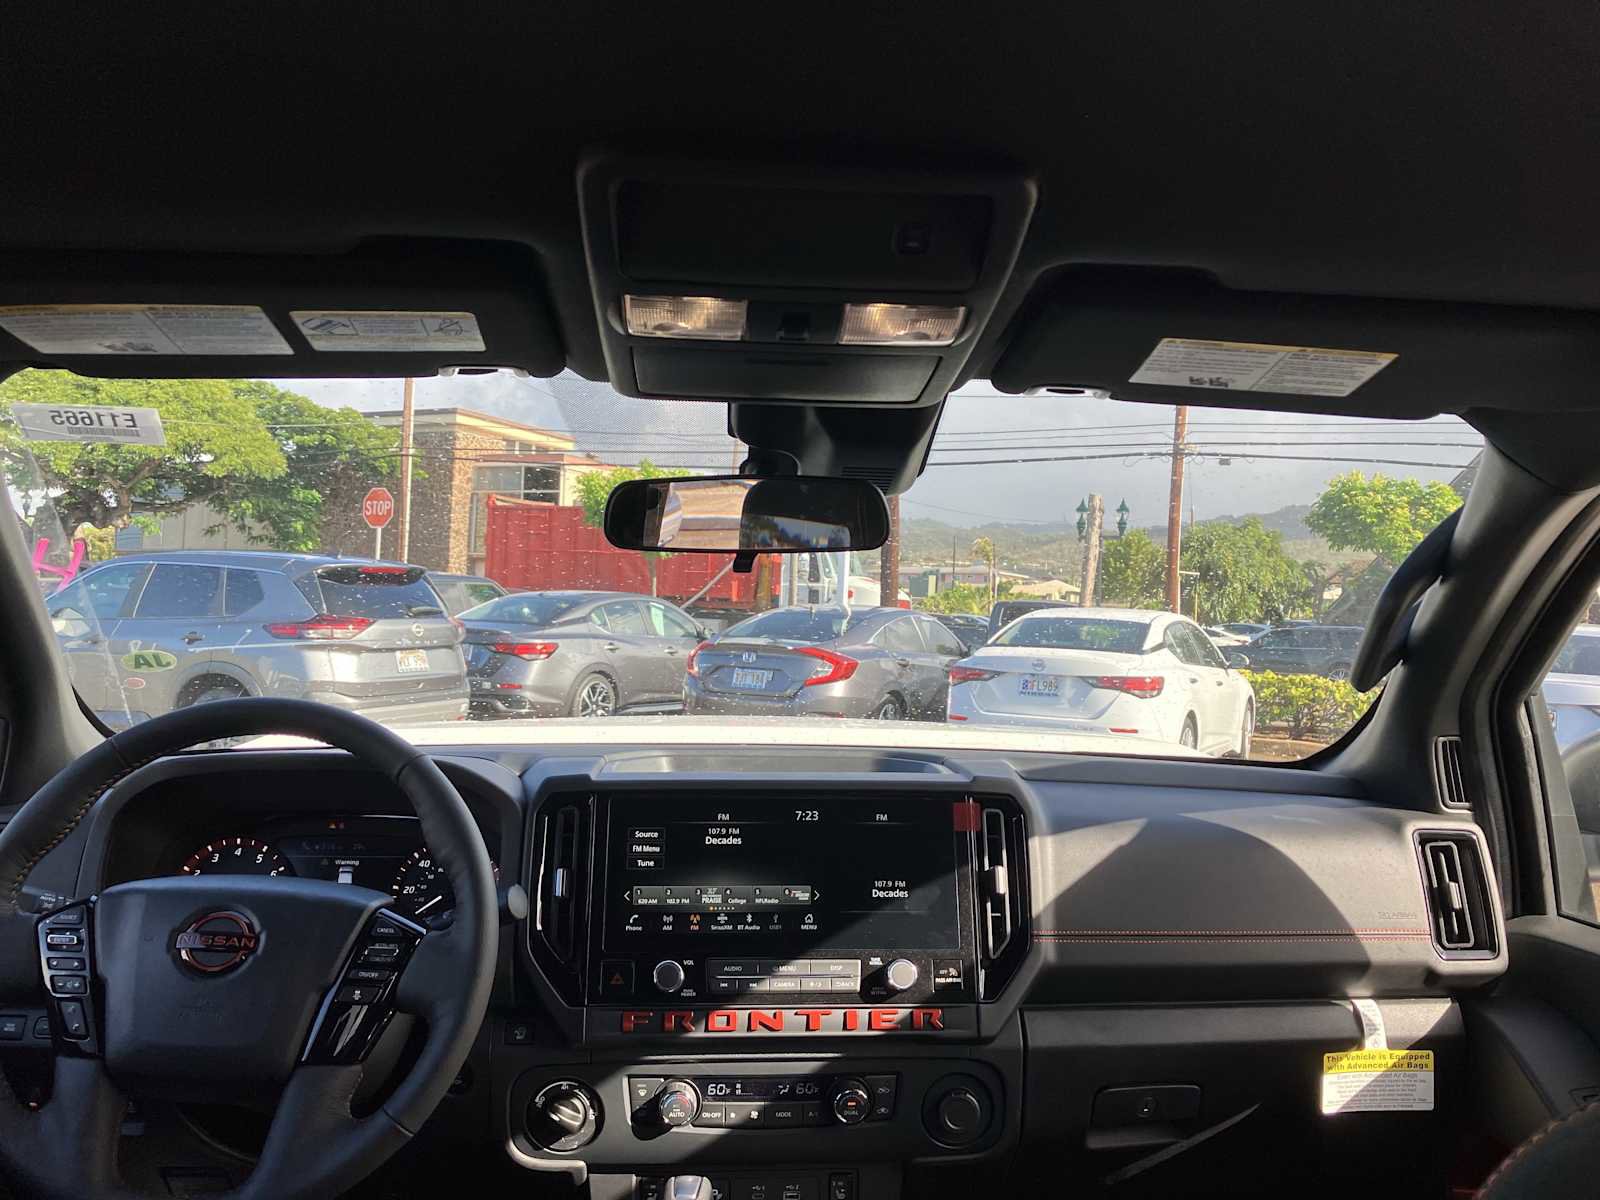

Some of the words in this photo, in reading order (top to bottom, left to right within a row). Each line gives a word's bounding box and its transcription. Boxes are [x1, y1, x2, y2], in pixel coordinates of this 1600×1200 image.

[365, 500, 391, 515] STOP
[717, 813, 730, 821] FM
[795, 810, 819, 821] 7:23
[634, 830, 659, 838] Source
[705, 836, 742, 845] Decades
[234, 847, 242, 857] 4
[632, 845, 642, 853] FM
[643, 845, 660, 853] Menu
[212, 853, 219, 863] 3
[256, 853, 263, 863] 5
[335, 859, 360, 867] Warning
[418, 859, 430, 868] 40
[637, 859, 655, 867] Tune
[874, 880, 892, 888] 107.9
[894, 880, 906, 888] FM
[403, 886, 415, 895] 20
[872, 889, 909, 898] Decades
[182, 935, 256, 948] NISSAN
[779, 964, 798, 972] MENU
[622, 1007, 944, 1032] FRONTIER
[1346, 1053, 1376, 1061] Vehicle
[1380, 1052, 1387, 1060] is
[1390, 1053, 1430, 1062] Equipped
[1347, 1062, 1389, 1070] Advanced
[1407, 1062, 1429, 1070] Bags
